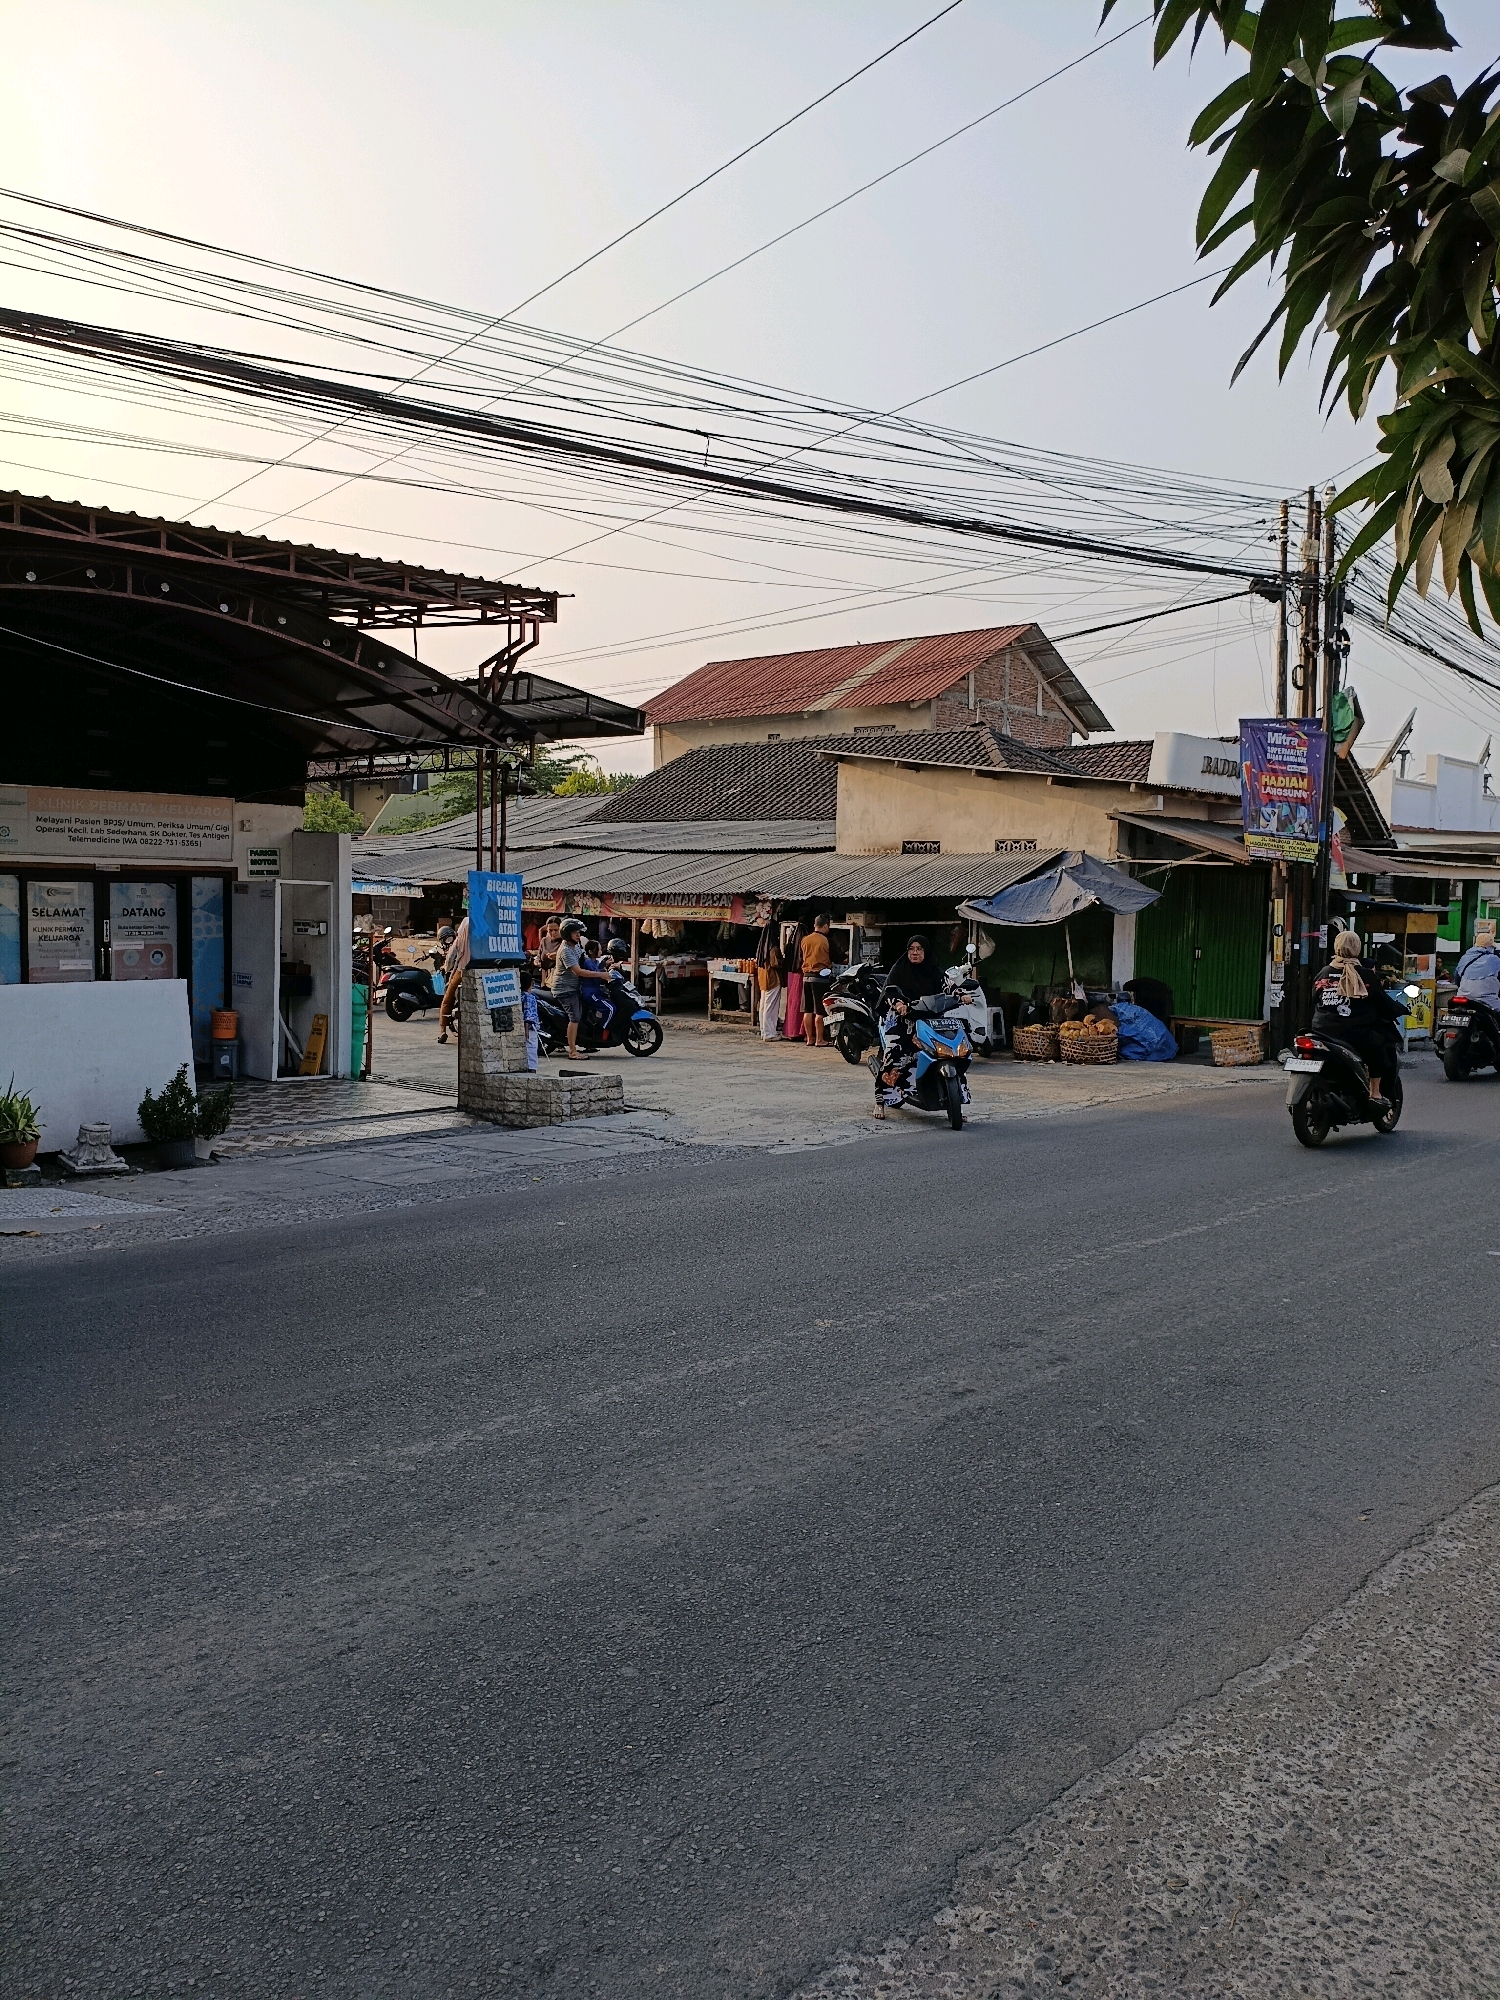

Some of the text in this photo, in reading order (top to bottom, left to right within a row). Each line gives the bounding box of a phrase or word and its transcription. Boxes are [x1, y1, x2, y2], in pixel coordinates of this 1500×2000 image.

[1261, 774, 1308, 789] HADIAH
[38, 796, 84, 810] KLINIK
[89, 799, 156, 814] PERMATA
[159, 803, 231, 818] KELUARGA
[36, 815, 72, 825] Melayani
[74, 816, 101, 826] Pasien
[157, 821, 184, 830] Periksa
[215, 824, 230, 832] Gigi
[35, 825, 66, 834] Operasi
[149, 830, 160, 838] SK
[190, 832, 201, 840] Tes
[202, 832, 230, 841] Antigen
[68, 835, 120, 844] Telemedicine
[486, 880, 518, 894] BICARA
[525, 886, 554, 900] SNACK
[496, 894, 517, 907] YANG
[612, 892, 733, 908] ANEKA JAJANAN PASAR
[32, 907, 86, 918] SELAMAT
[122, 907, 166, 918] DATANG
[498, 908, 517, 921] BAIK
[498, 922, 518, 935] ATAU
[38, 934, 81, 942] KELUARGA
[488, 936, 519, 953] DIAM
[485, 974, 514, 984] PARKIR
[487, 983, 516, 995] MOTOR
